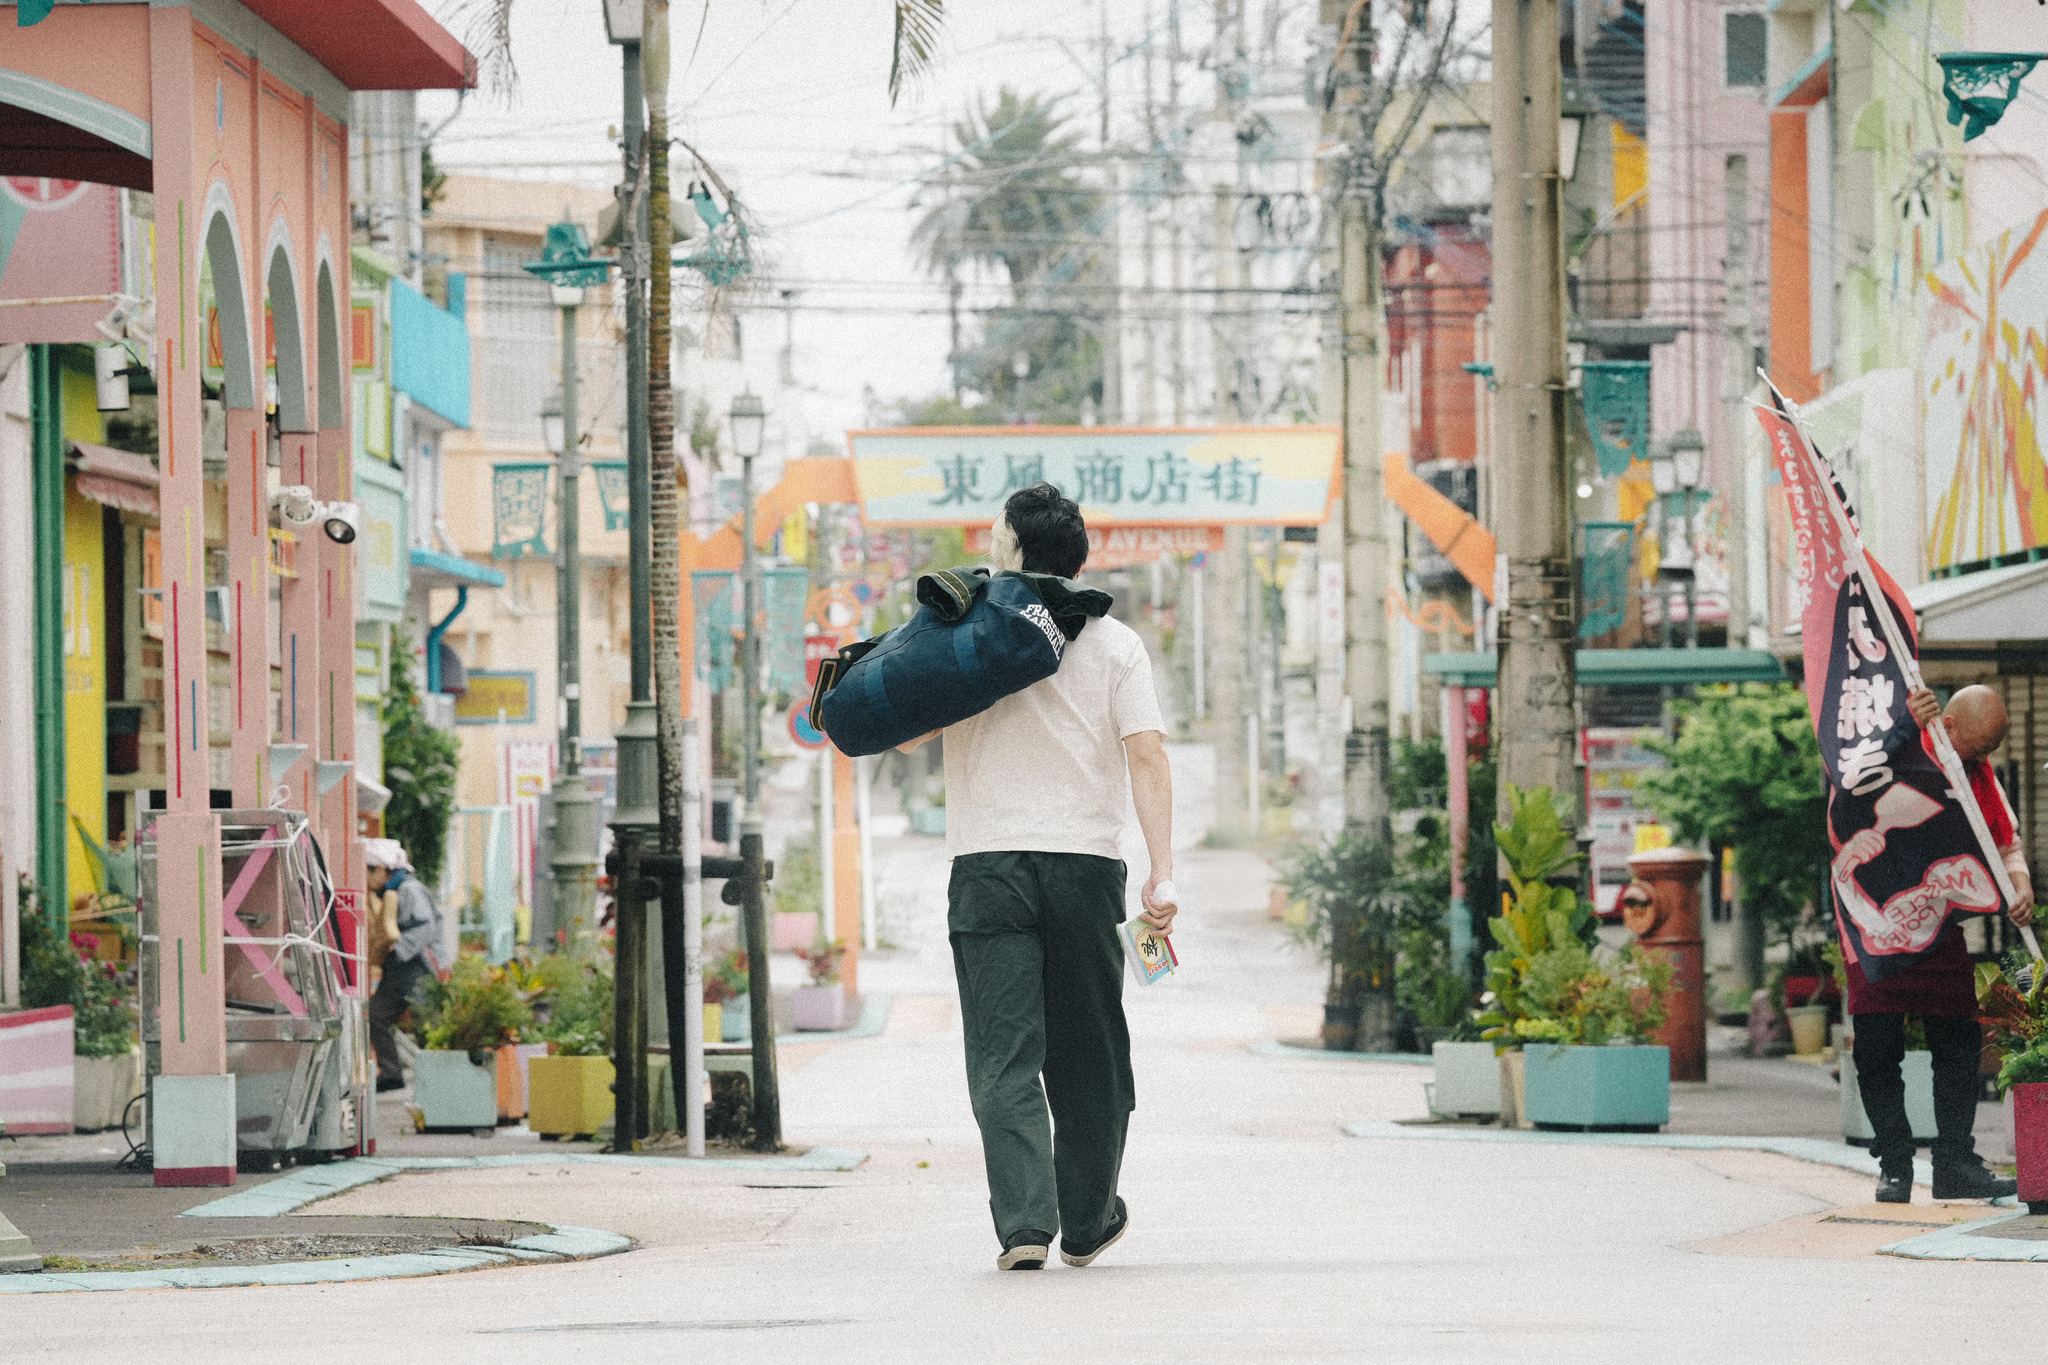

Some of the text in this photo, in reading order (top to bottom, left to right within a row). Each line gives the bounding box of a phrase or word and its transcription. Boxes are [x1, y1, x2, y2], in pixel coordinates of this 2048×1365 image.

[928, 449, 1262, 507] 東風商店街
[1106, 527, 1209, 551] AVENUE
